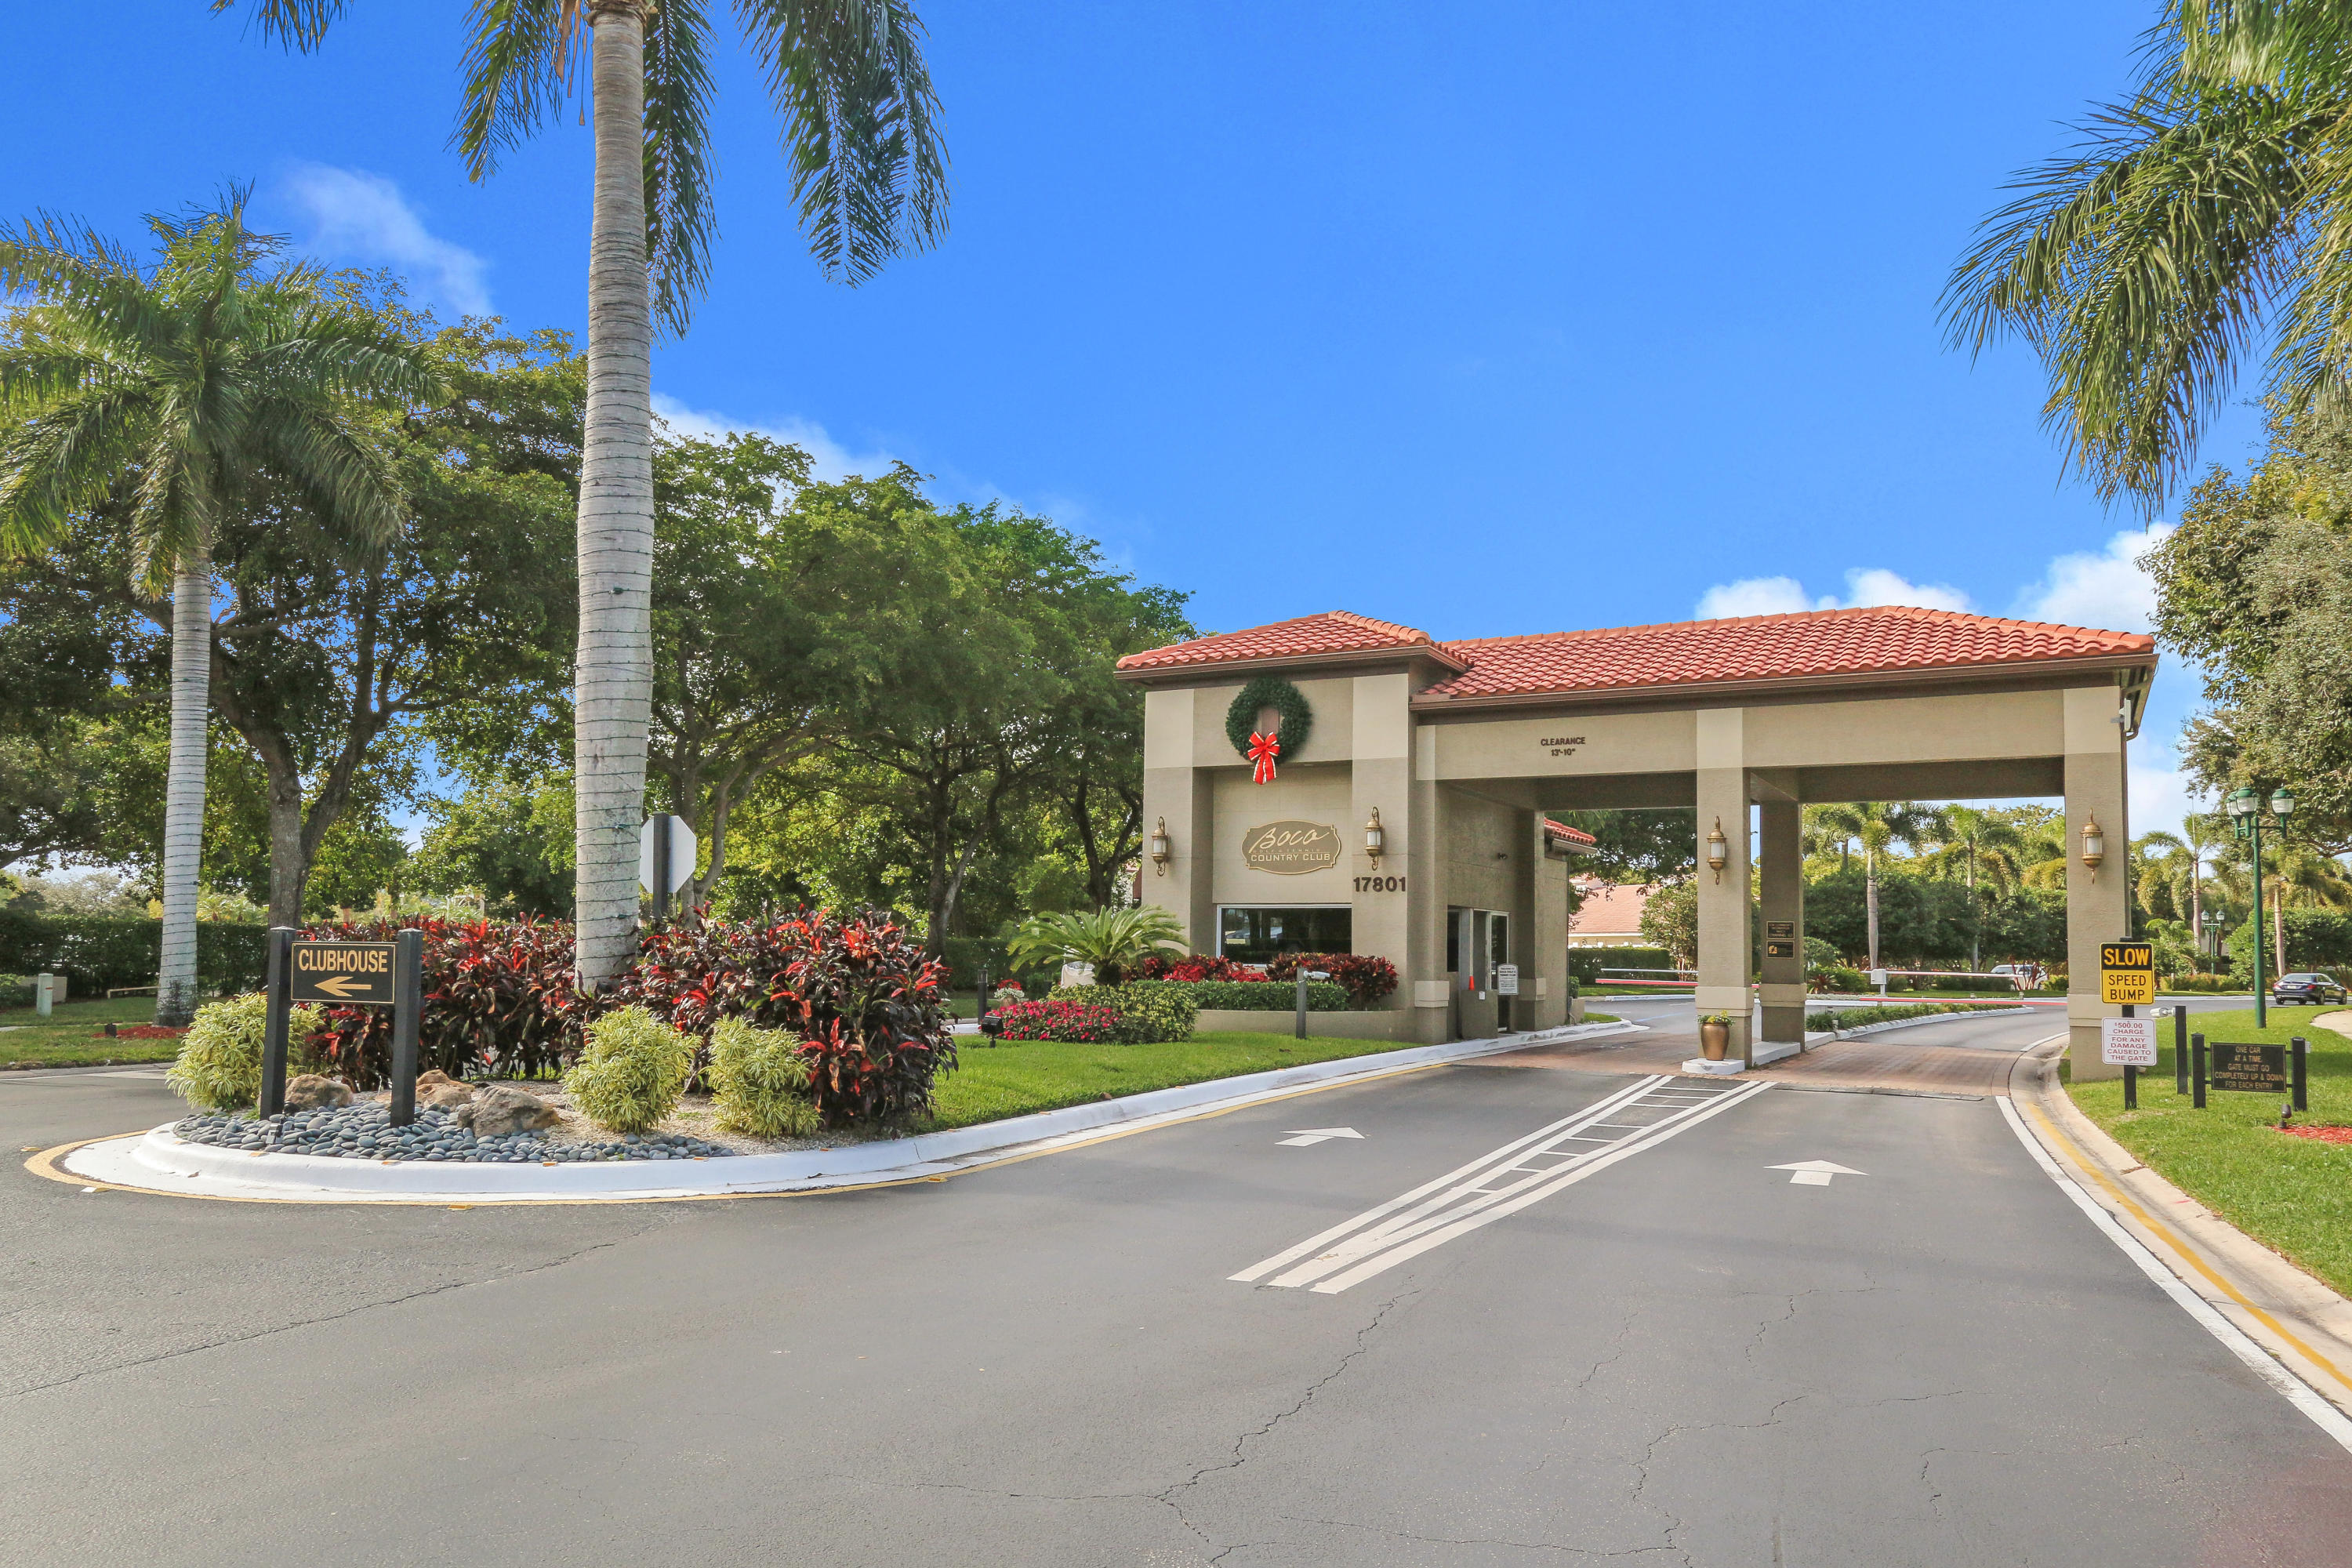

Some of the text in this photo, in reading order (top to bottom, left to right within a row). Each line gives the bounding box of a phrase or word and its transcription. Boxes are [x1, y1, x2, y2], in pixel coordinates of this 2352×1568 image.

[1541, 737, 1586, 746] CLEARANCE
[1249, 827, 1330, 854] Boca
[1353, 877, 1406, 892] 17801
[299, 949, 388, 972] CLUBHOUSE
[2103, 948, 2150, 965] SLOW
[2108, 975, 2147, 986] SPEED
[2110, 989, 2145, 1000] BUMP
[2215, 1071, 2249, 1080] COMPLETELY
